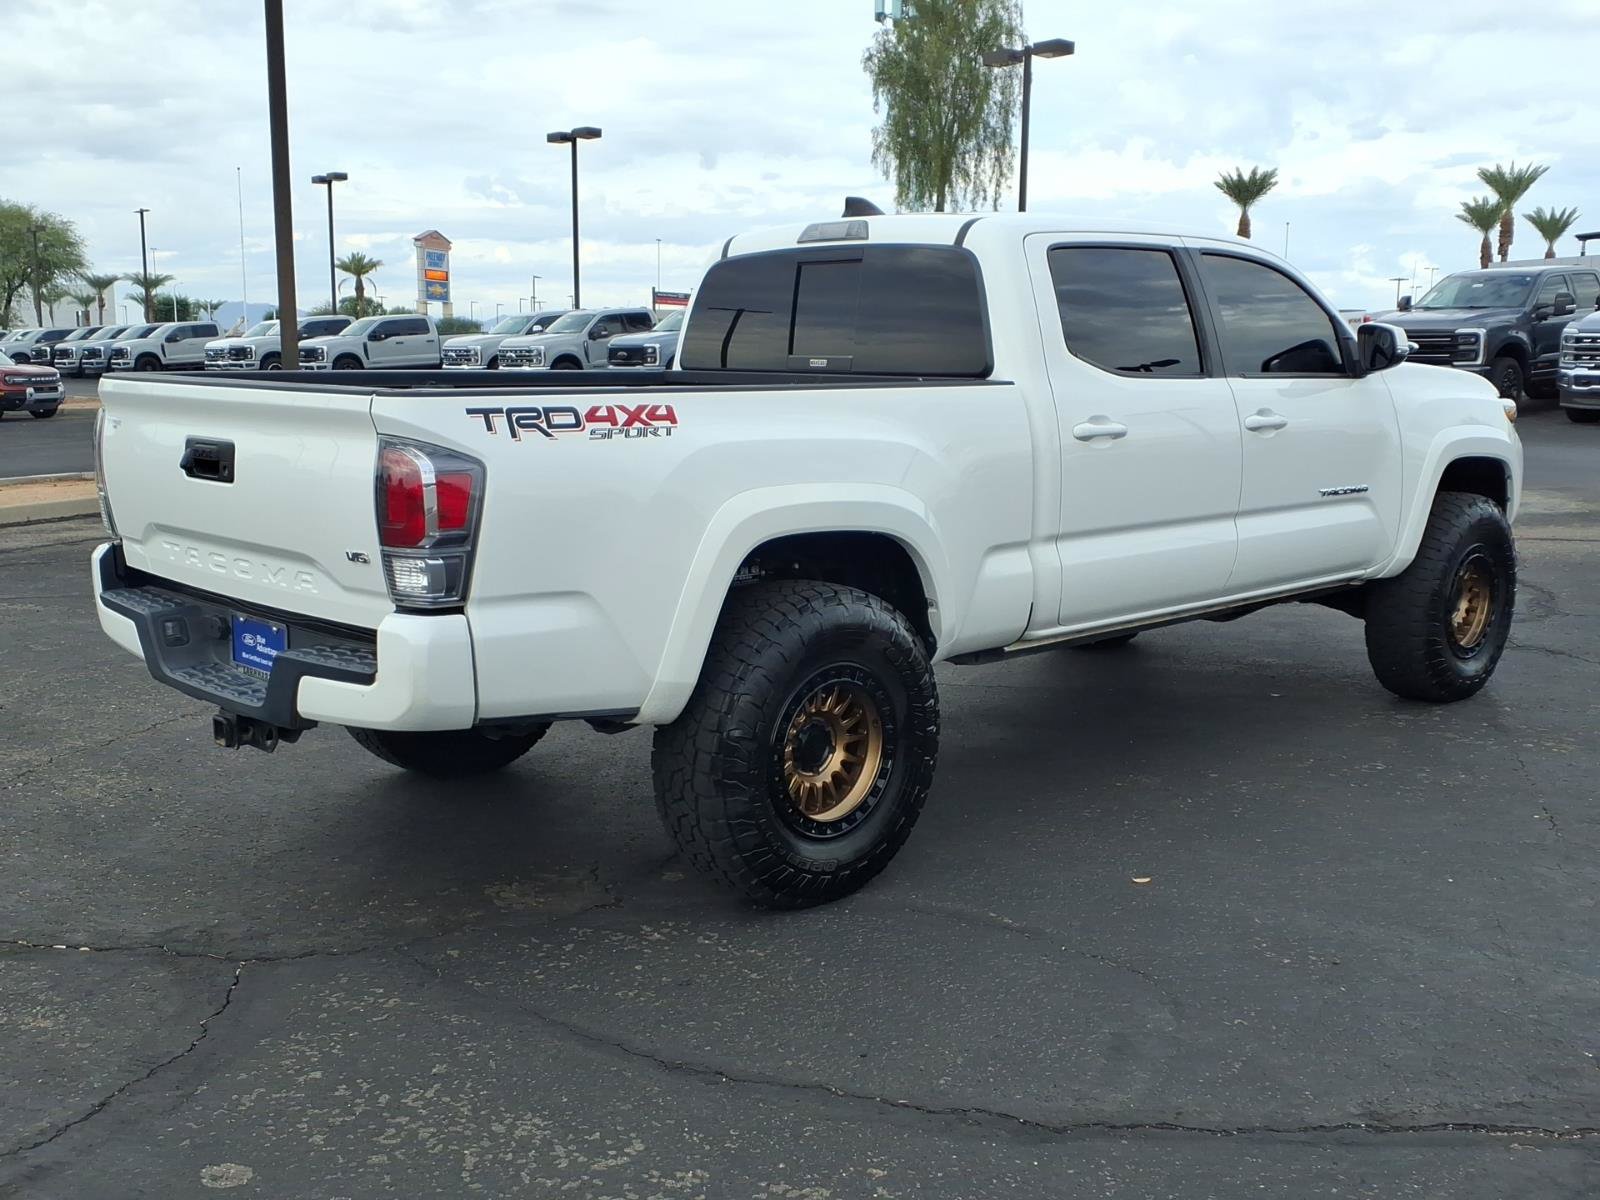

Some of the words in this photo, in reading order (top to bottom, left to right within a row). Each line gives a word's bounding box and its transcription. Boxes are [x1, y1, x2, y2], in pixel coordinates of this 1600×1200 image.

[465, 406, 586, 441] TRD
[585, 404, 678, 426] 4X4
[589, 425, 678, 440] SPORT
[1319, 484, 1369, 497] TACOMA
[345, 551, 370, 564] V6
[162, 540, 320, 594] TACOMA
